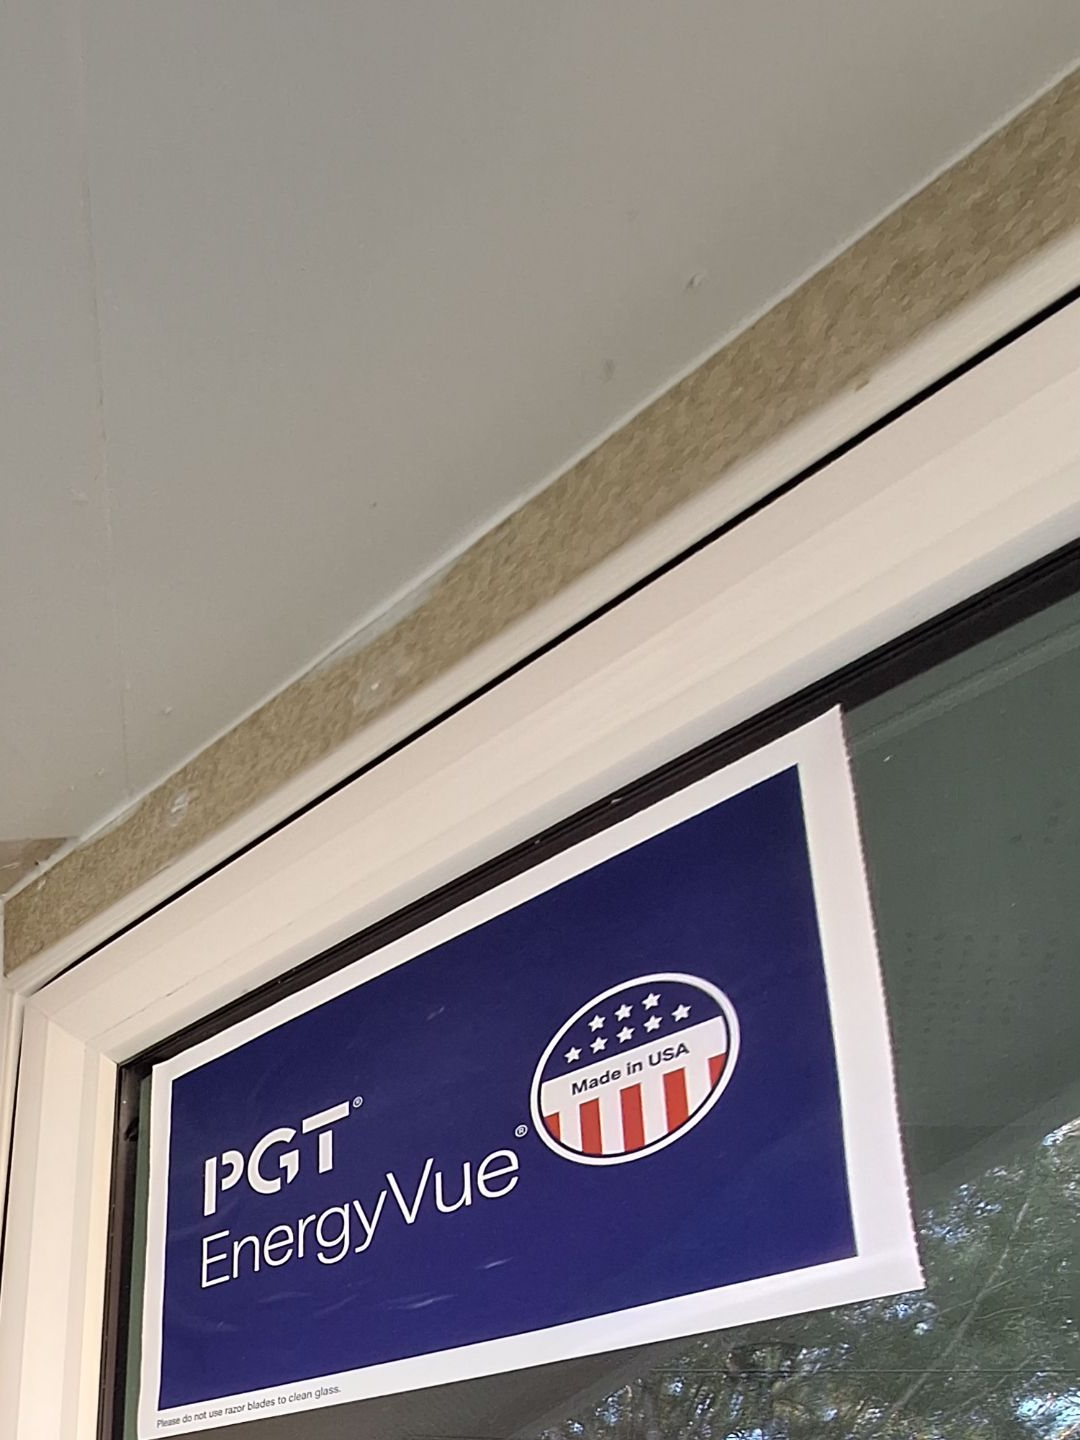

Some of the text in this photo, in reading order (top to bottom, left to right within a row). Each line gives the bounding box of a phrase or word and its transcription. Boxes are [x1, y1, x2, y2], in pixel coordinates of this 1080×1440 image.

[571, 1042, 690, 1096] Made in USA
[156, 1386, 342, 1428] Please do not use razor blades to clean glass.
